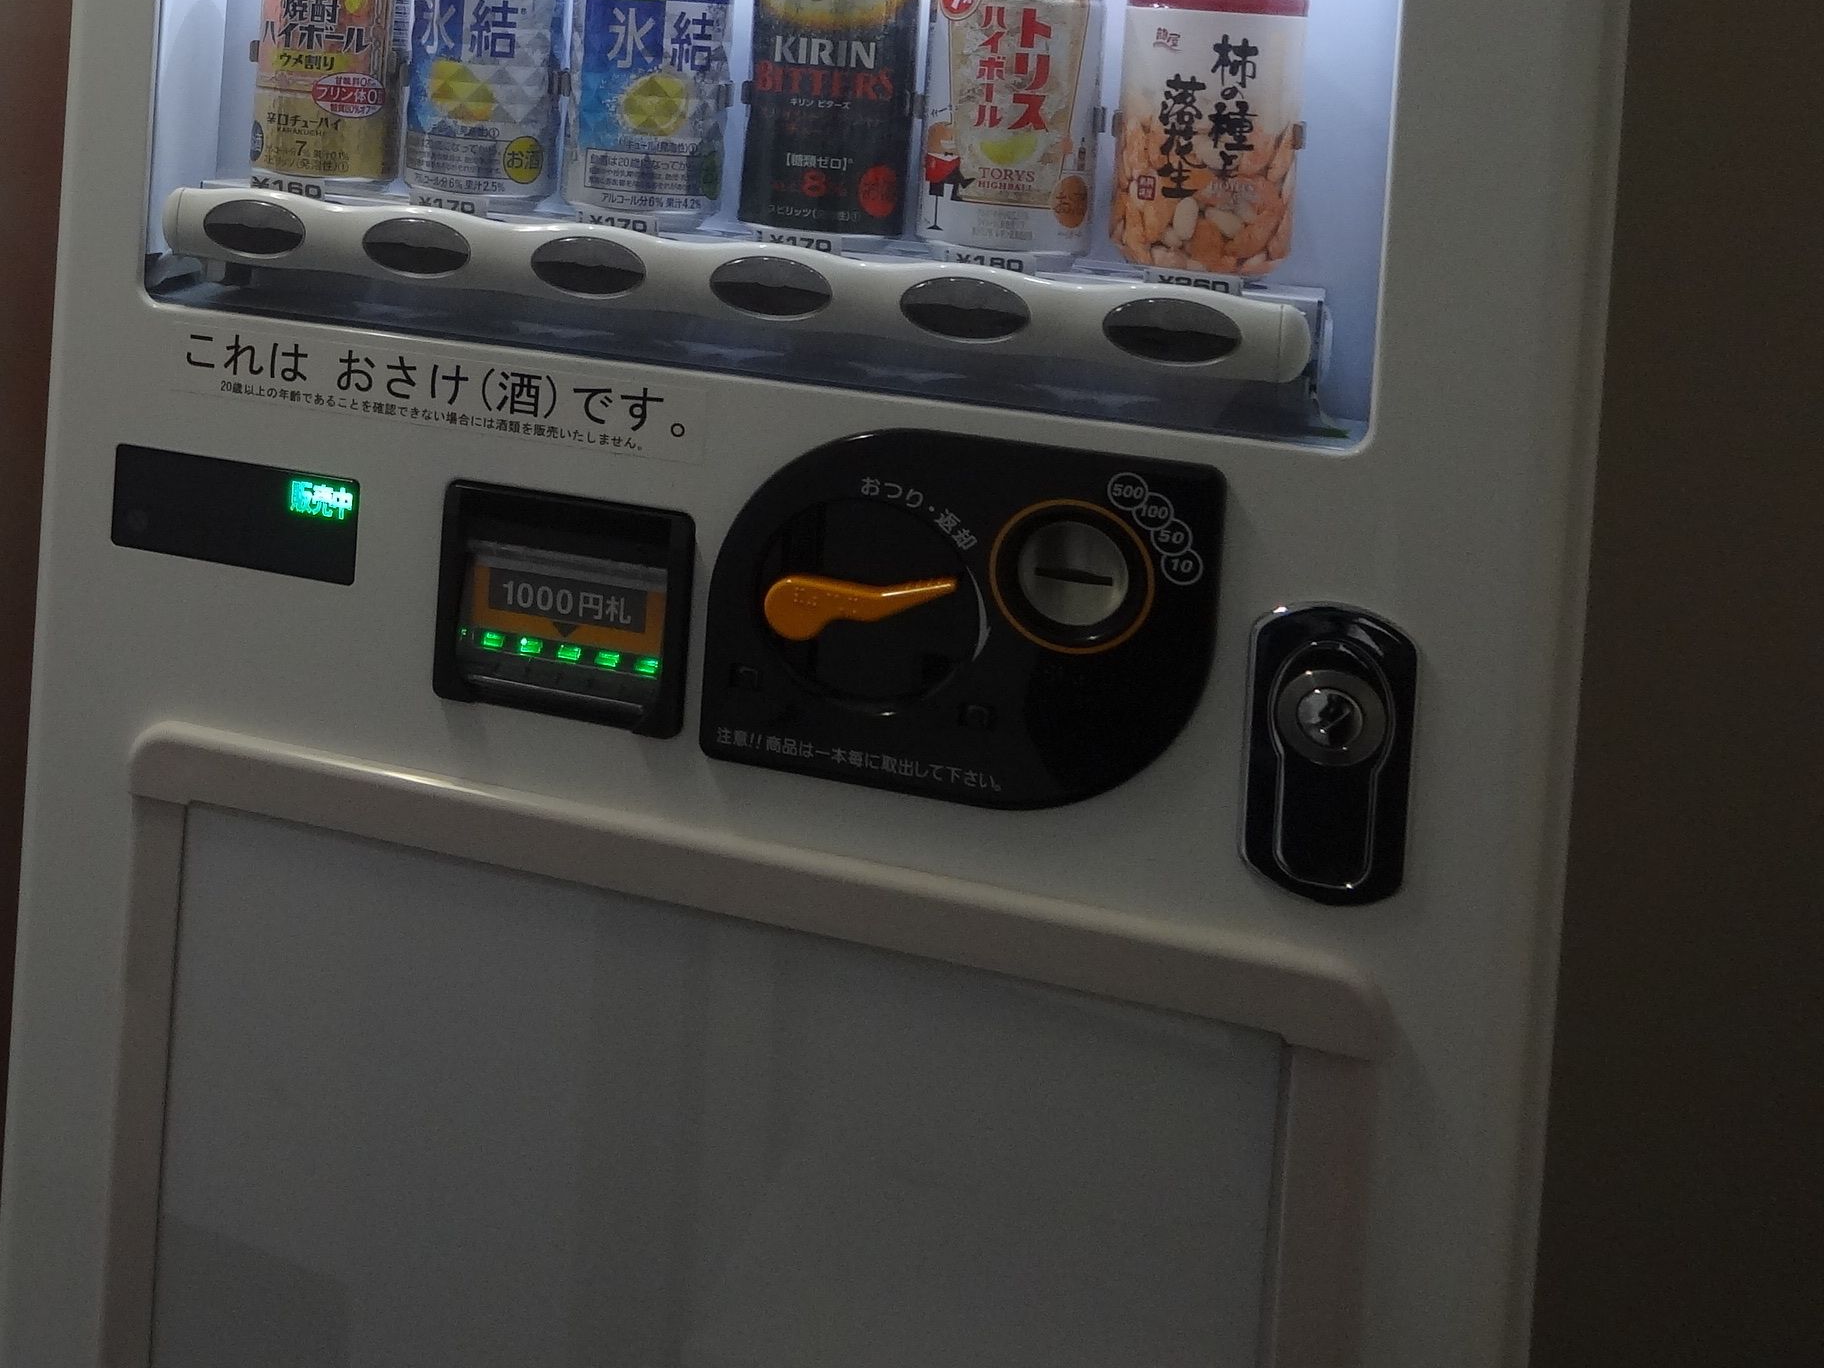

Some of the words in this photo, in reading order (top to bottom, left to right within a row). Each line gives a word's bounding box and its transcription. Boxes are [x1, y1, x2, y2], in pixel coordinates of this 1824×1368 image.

[263, 19, 373, 54] ハイボール
[606, 7, 715, 73] 氷結
[773, 34, 878, 70] KIRIN
[975, 5, 1008, 129] ハイボール
[1012, 7, 1053, 132] トリス
[251, 176, 322, 199] ¥160
[977, 167, 1036, 183] TORYS
[185, 332, 309, 383] これは
[219, 380, 644, 452] 20歳以上の年齢であることを確認できない場合には酒類を販売いたしません。
[289, 479, 354, 521] 販売中
[1112, 482, 1144, 500] 500
[1140, 502, 1170, 520] 100
[1157, 529, 1185, 546] 50
[1169, 557, 1195, 574] 10
[502, 580, 632, 625] 1000円札
